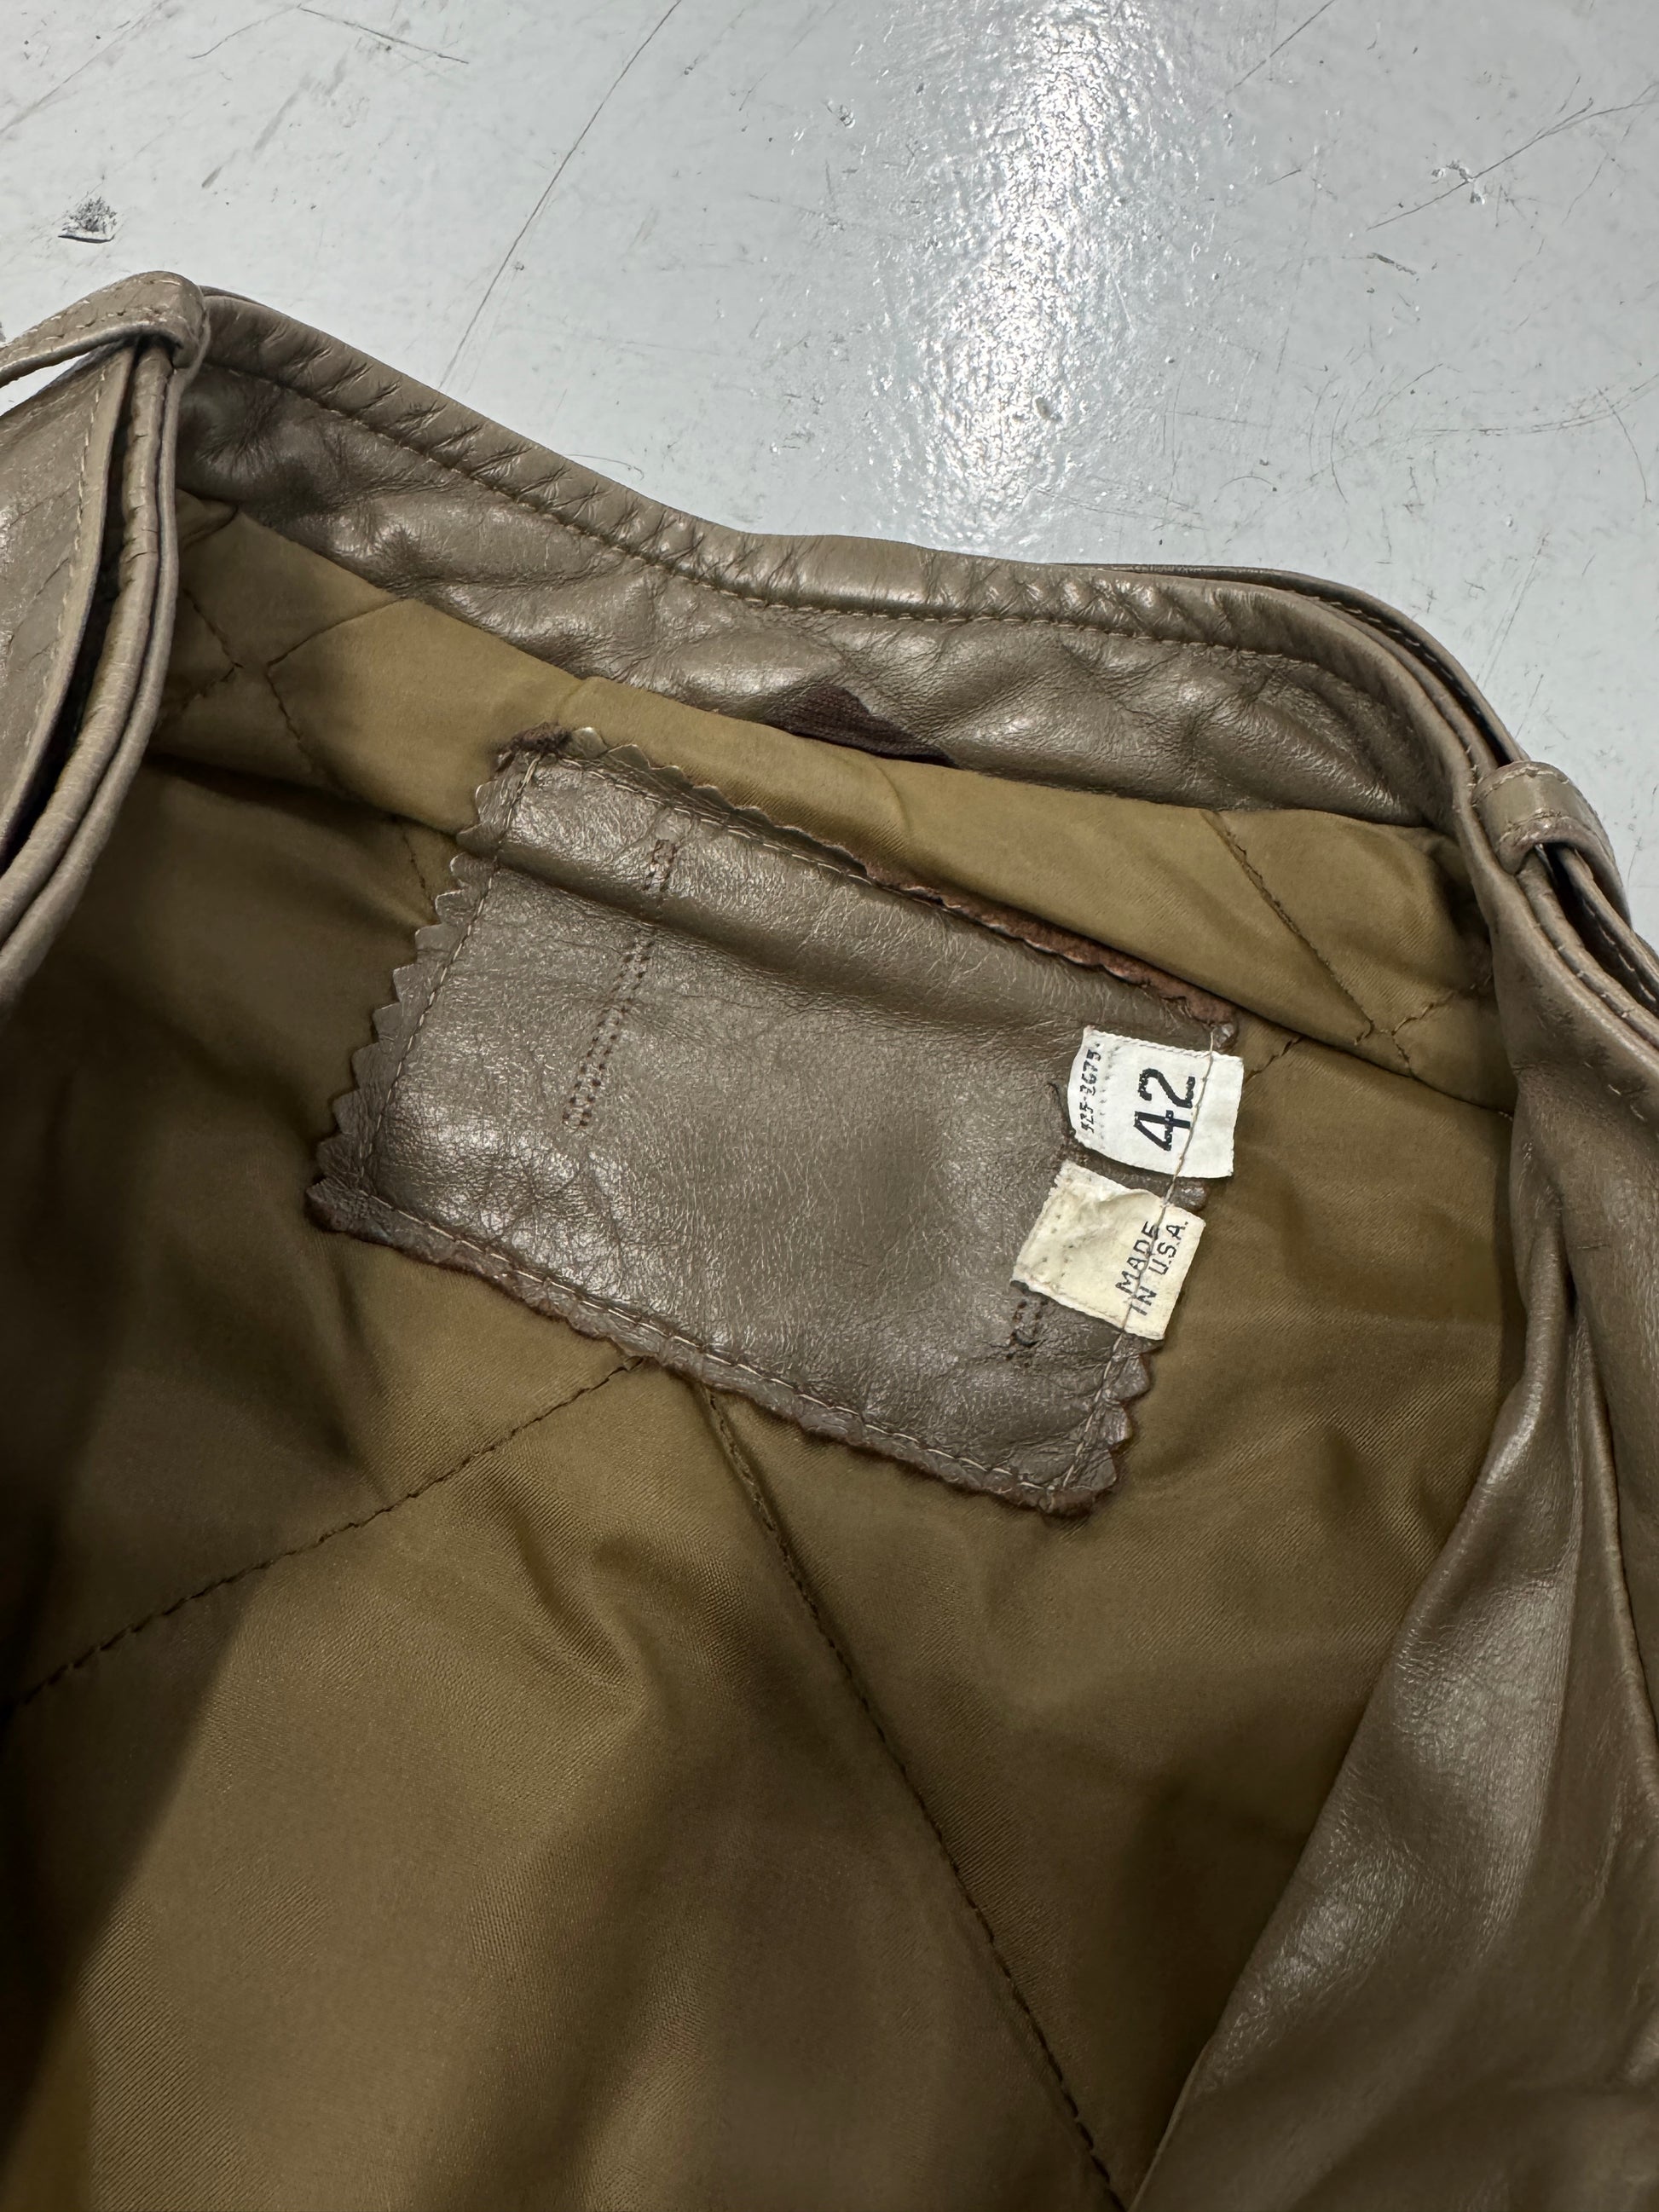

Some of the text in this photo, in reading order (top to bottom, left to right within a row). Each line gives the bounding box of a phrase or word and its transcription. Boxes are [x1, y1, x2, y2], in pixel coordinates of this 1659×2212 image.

[1133, 1067, 1195, 1151] 42
[1116, 1221, 1159, 1297] MADE
[1130, 1285, 1157, 1316] IN
